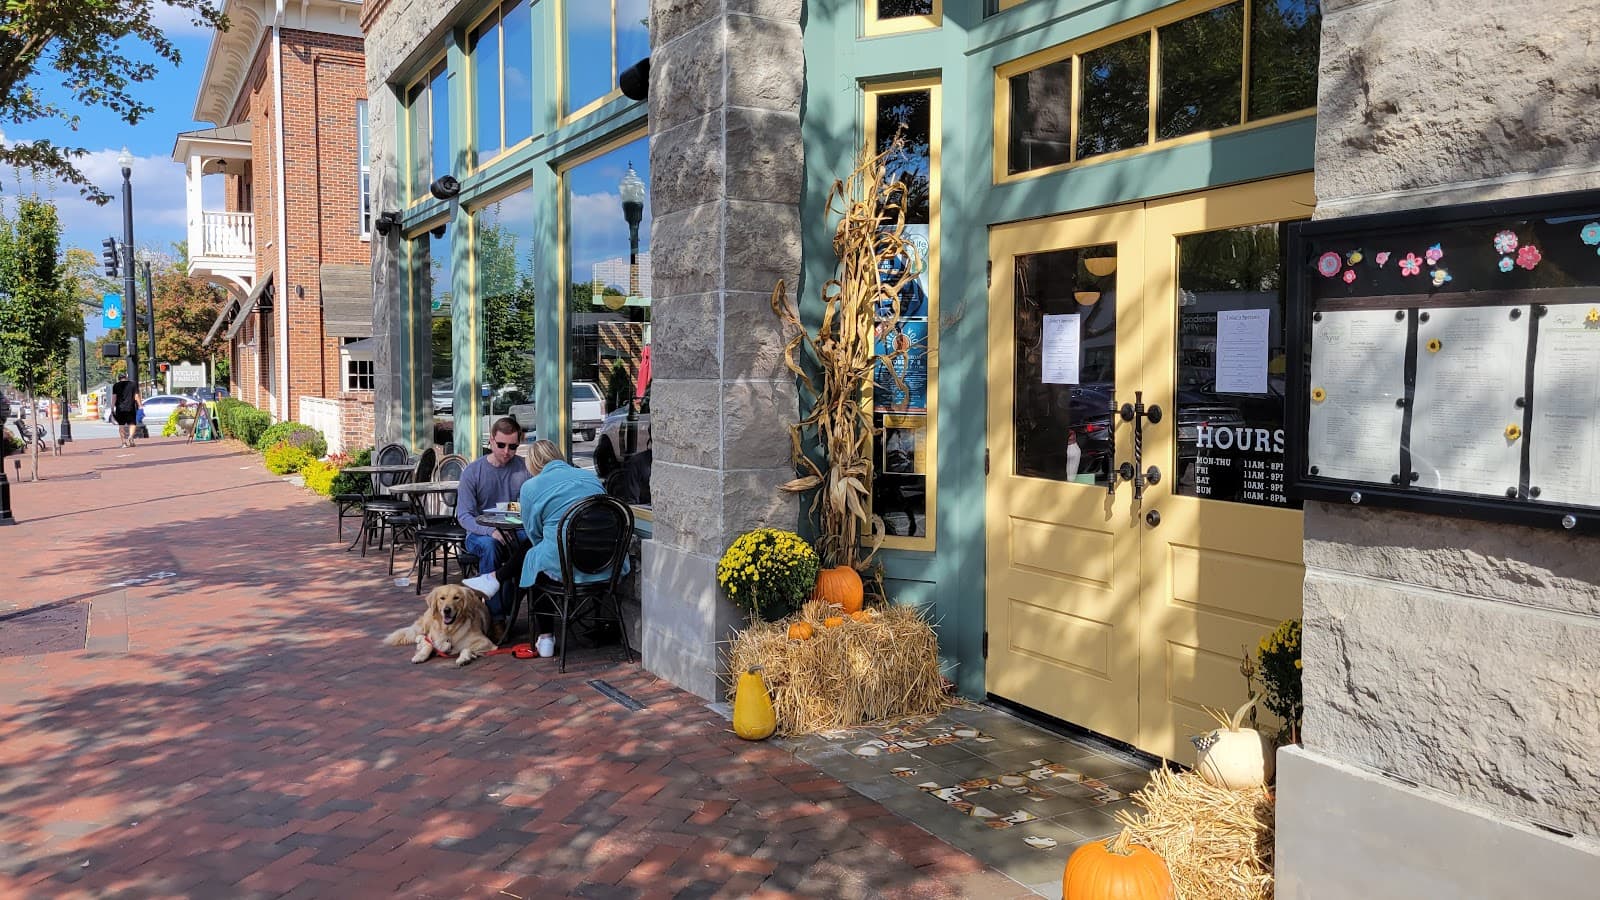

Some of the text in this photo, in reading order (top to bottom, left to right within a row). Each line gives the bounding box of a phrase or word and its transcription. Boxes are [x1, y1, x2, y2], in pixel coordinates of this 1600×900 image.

[1196, 426, 1284, 453] HOURS
[1196, 457, 1231, 466] MON-THU
[1243, 460, 1264, 469] 11AM
[1196, 466, 1208, 474] FRI
[1243, 470, 1264, 479] 11AM
[1196, 476, 1210, 484] SAT
[1243, 481, 1264, 490] 10AM
[1196, 485, 1211, 494] SUN
[1243, 491, 1264, 500] 10AM
